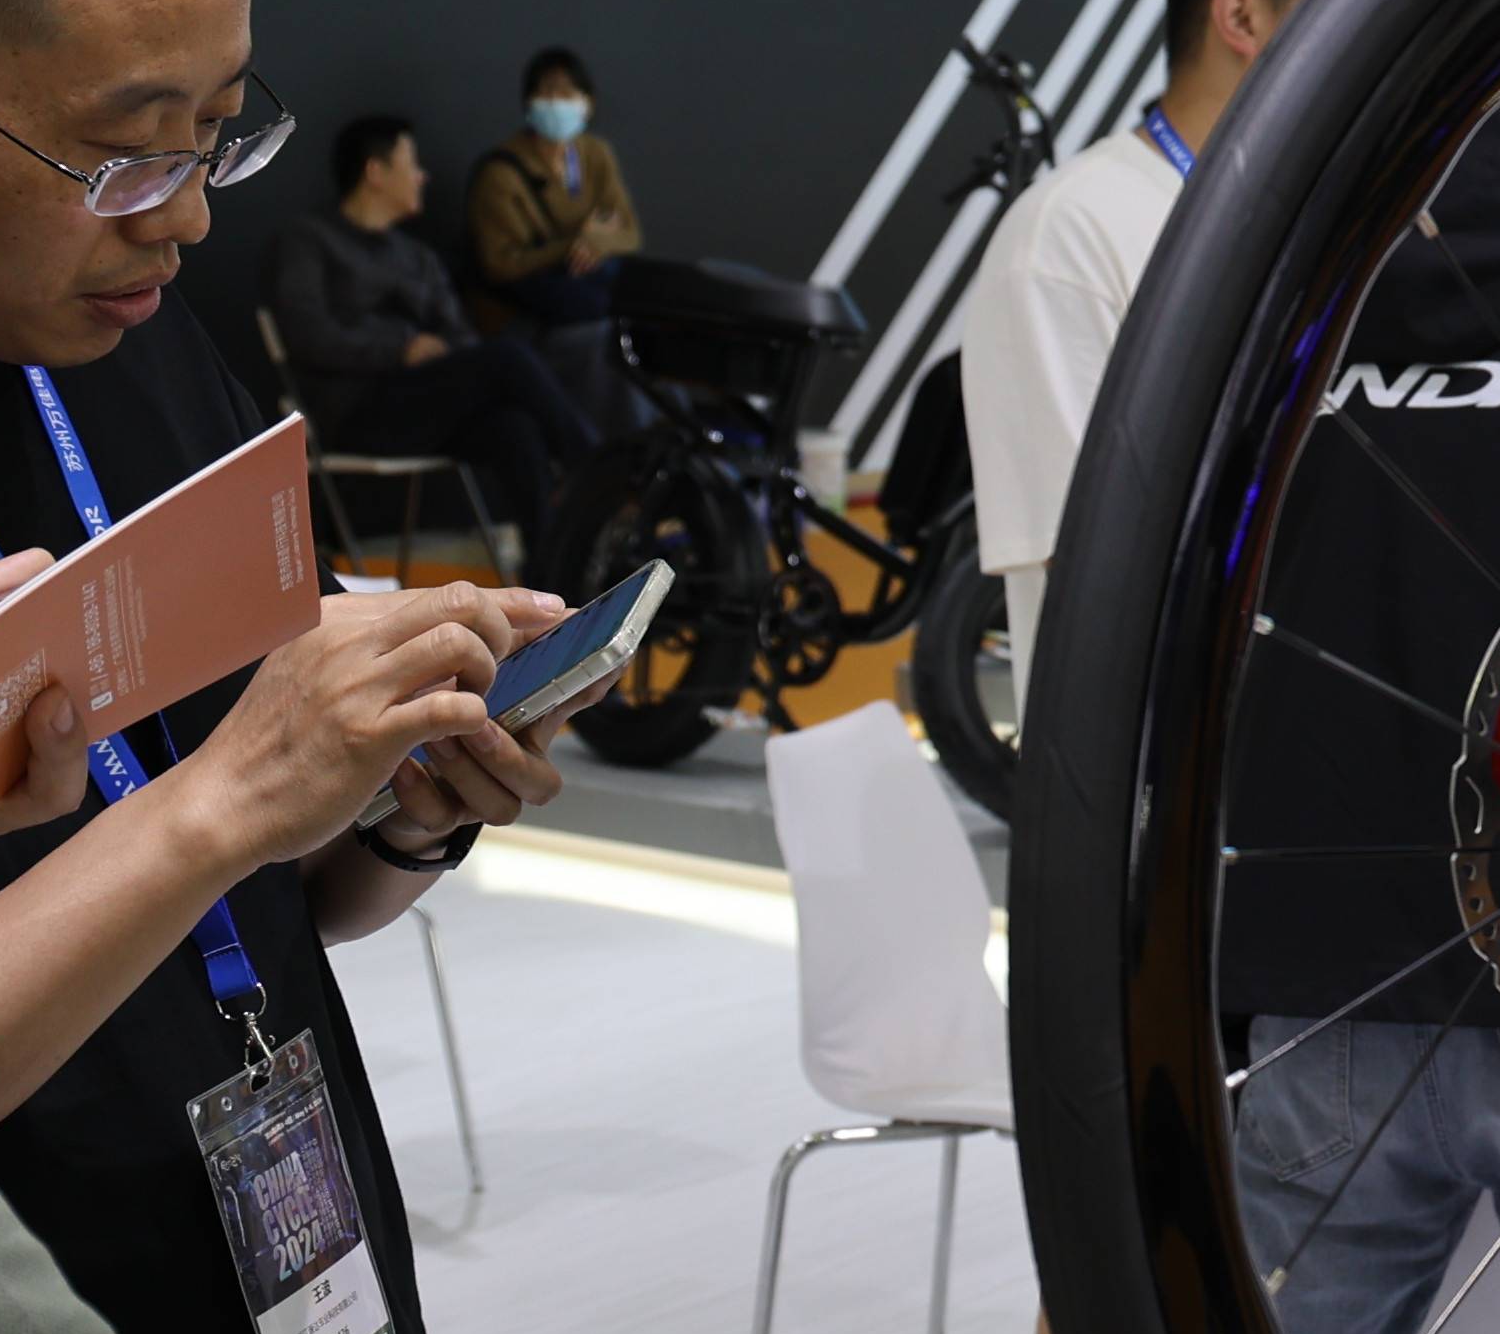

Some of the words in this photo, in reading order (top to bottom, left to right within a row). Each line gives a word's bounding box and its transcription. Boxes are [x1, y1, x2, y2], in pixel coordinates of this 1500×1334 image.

[253, 1150, 308, 1210] CHINA
[262, 1183, 318, 1246] CYCLE
[273, 1219, 323, 1282] 2024
